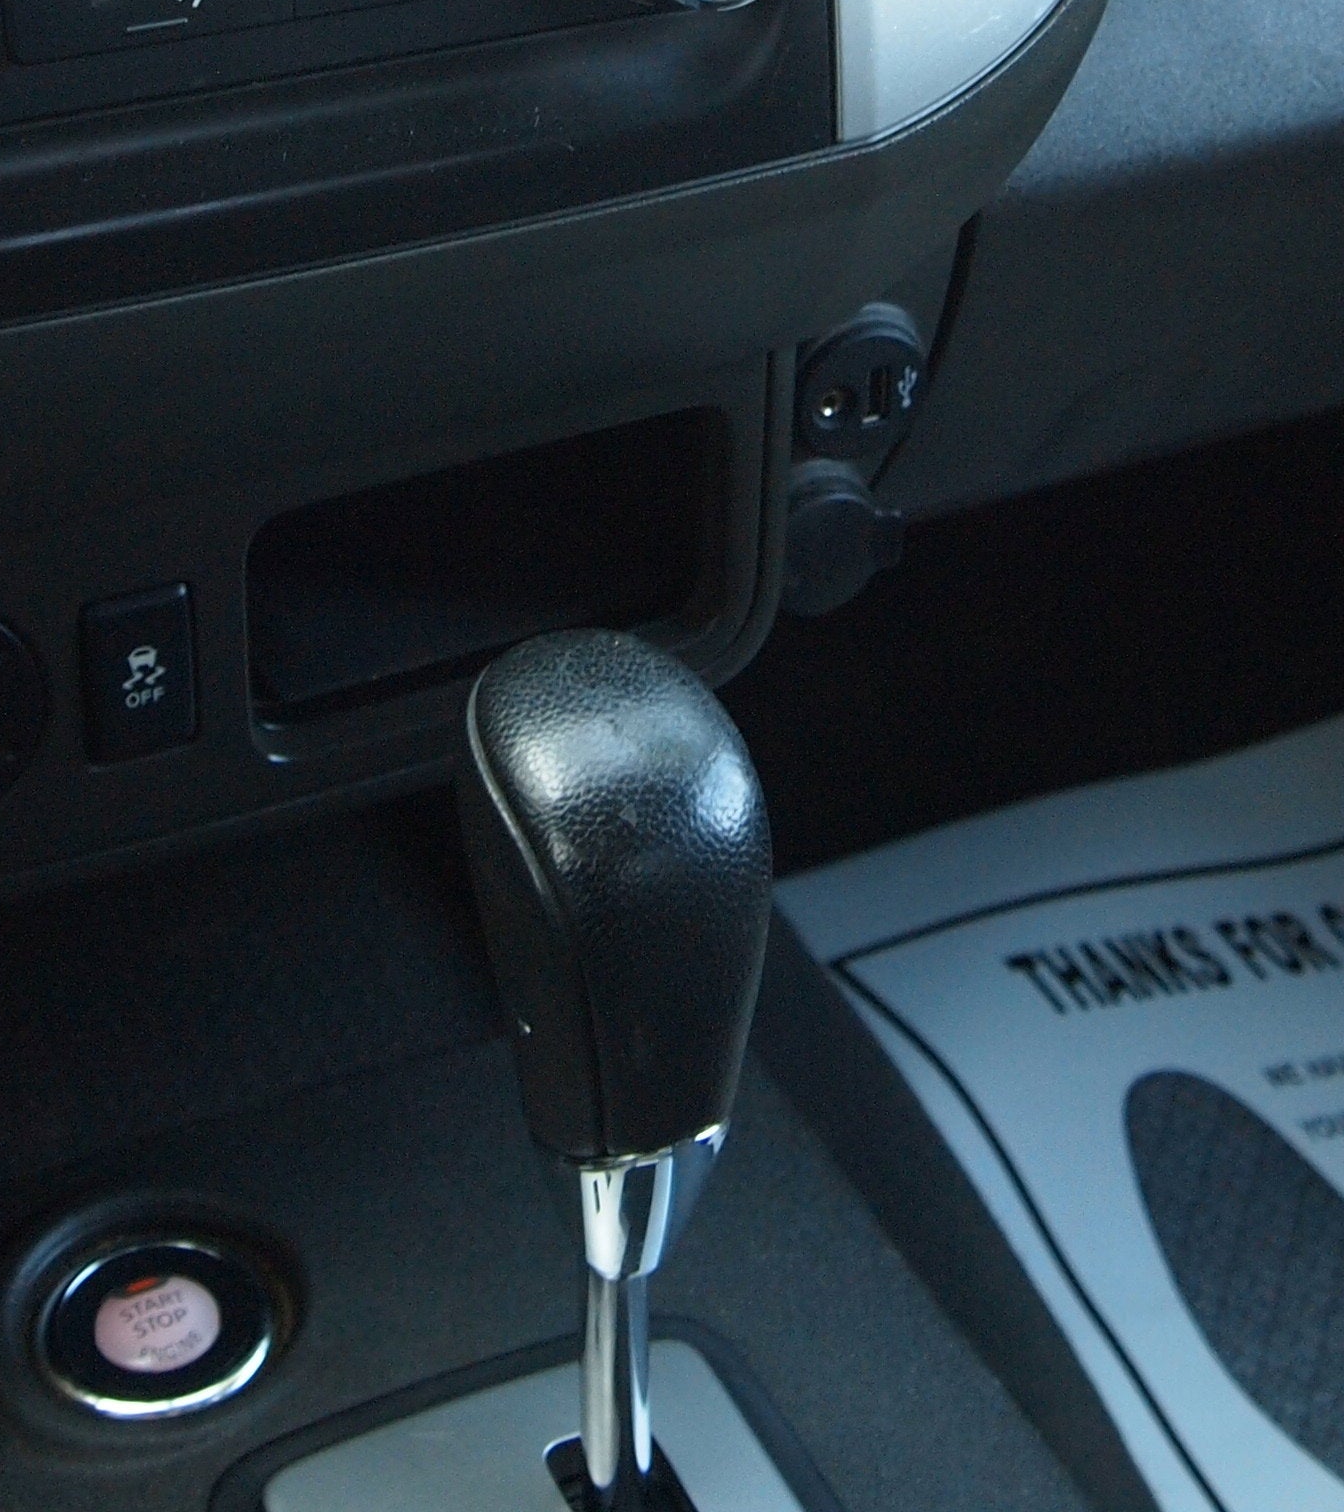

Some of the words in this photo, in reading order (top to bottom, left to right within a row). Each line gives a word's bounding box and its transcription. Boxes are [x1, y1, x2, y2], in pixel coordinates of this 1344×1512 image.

[124, 685, 165, 709] OFF
[1003, 924, 1234, 1015] THANKS
[1210, 909, 1343, 981] FOR
[118, 1289, 184, 1325] START
[132, 1307, 188, 1340] STOP
